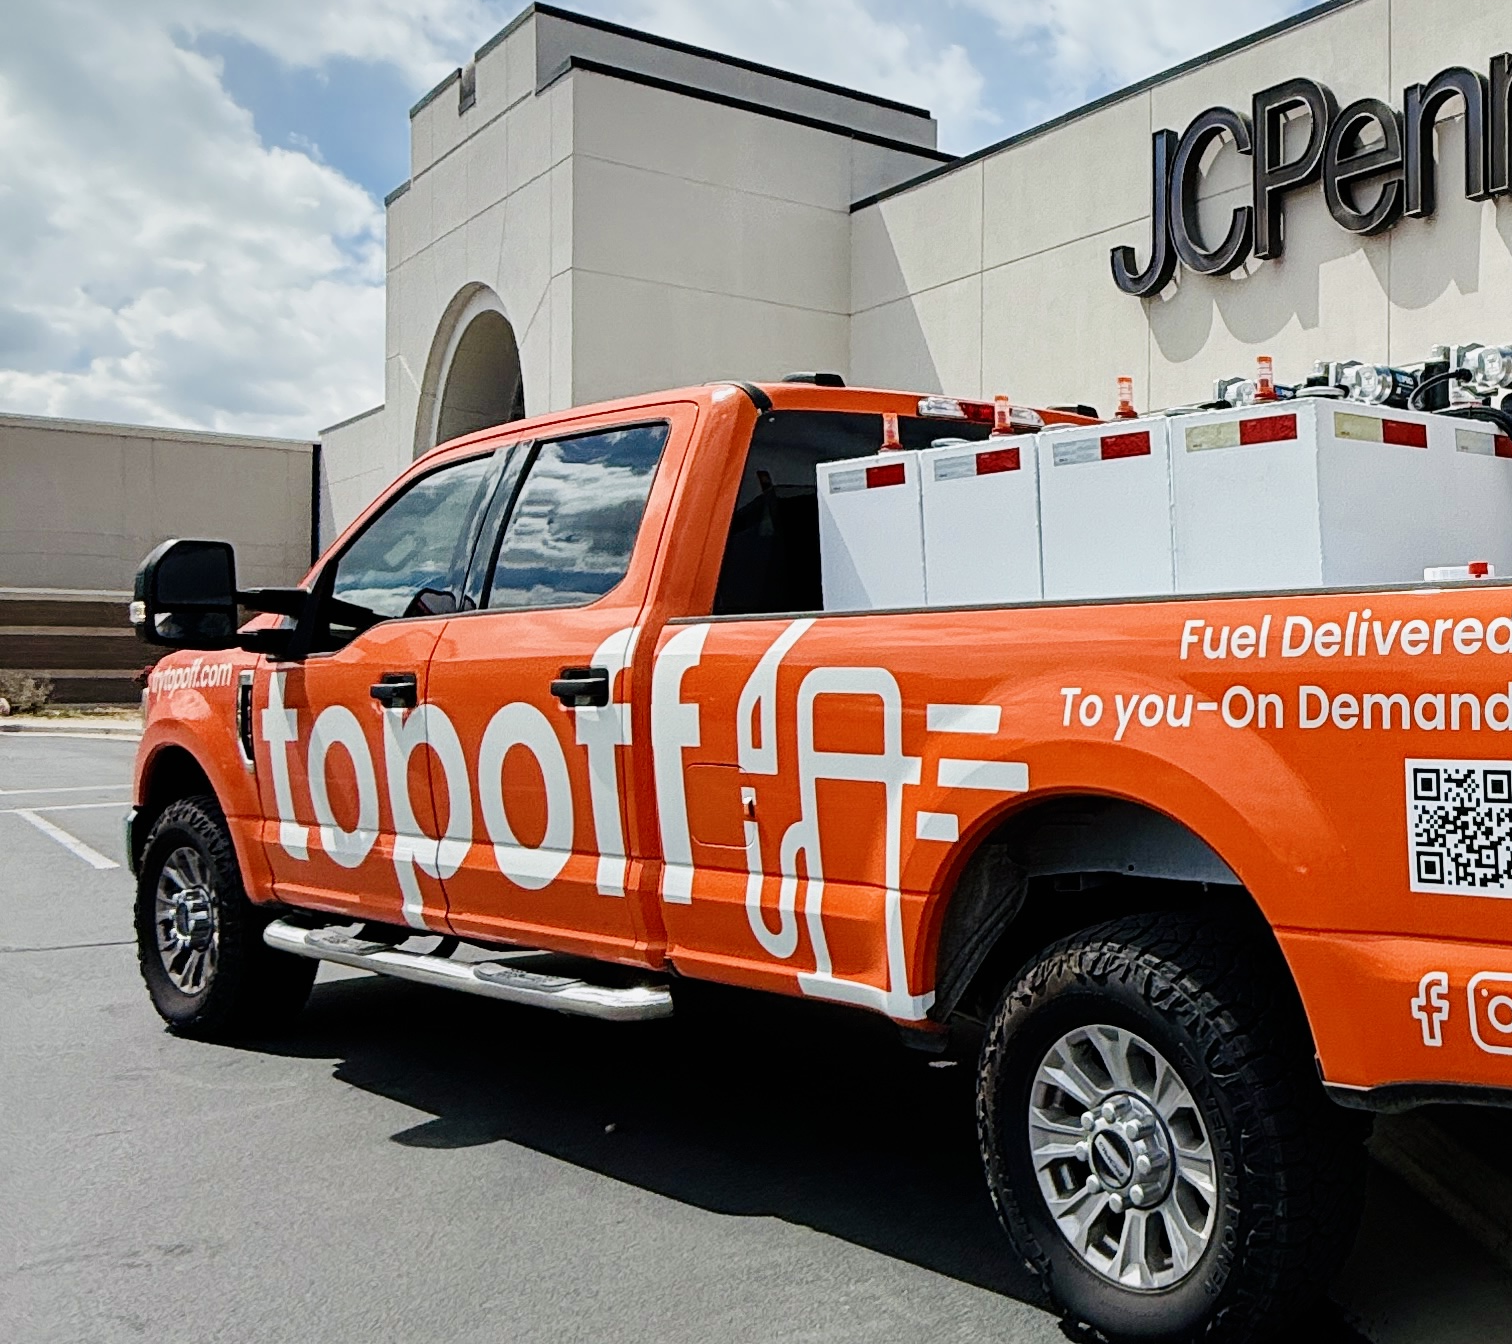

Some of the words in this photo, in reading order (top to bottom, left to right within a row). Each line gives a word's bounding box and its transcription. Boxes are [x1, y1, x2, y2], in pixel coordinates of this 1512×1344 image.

[1180, 614, 1272, 660] Fuel
[1060, 688, 1103, 727] To
[261, 623, 711, 931] topoff
